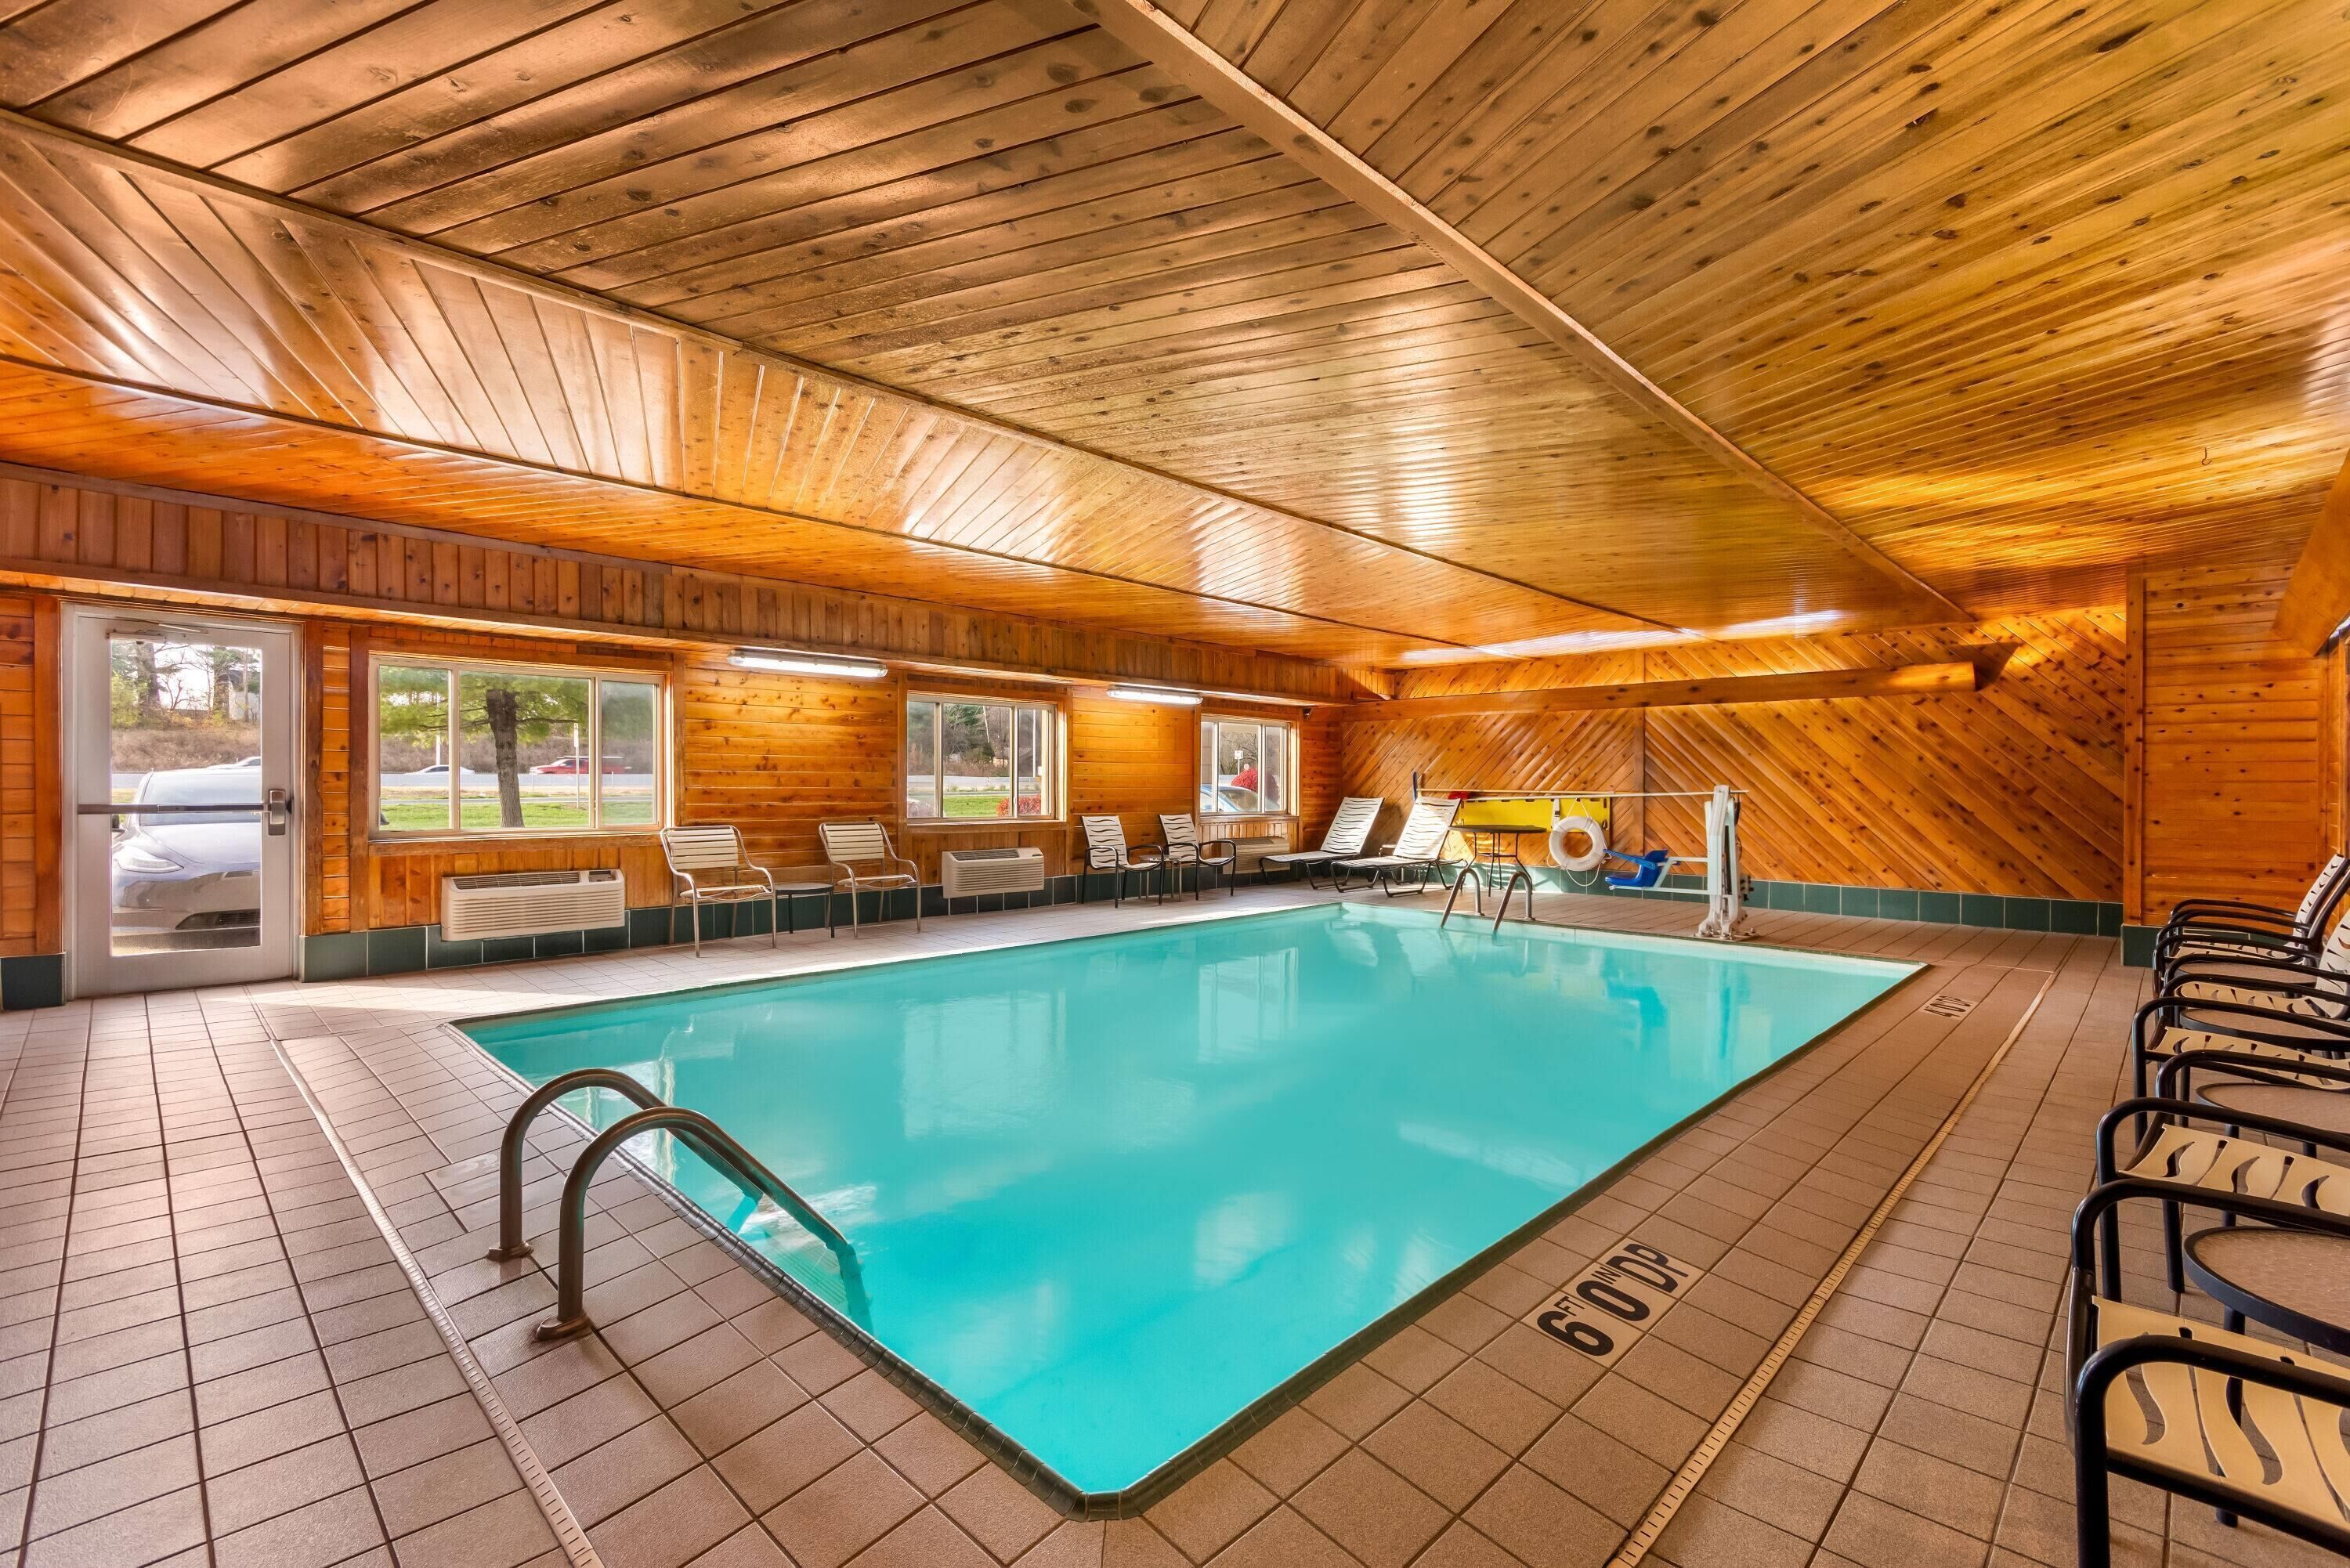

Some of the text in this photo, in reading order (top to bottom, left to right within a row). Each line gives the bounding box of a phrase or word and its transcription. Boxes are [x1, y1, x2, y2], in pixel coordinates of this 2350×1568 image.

[1929, 1003, 1966, 1012] 0
[1924, 1008, 1961, 1017] 4
[1537, 1243, 1688, 1357] 6 FT 0 IN DP
